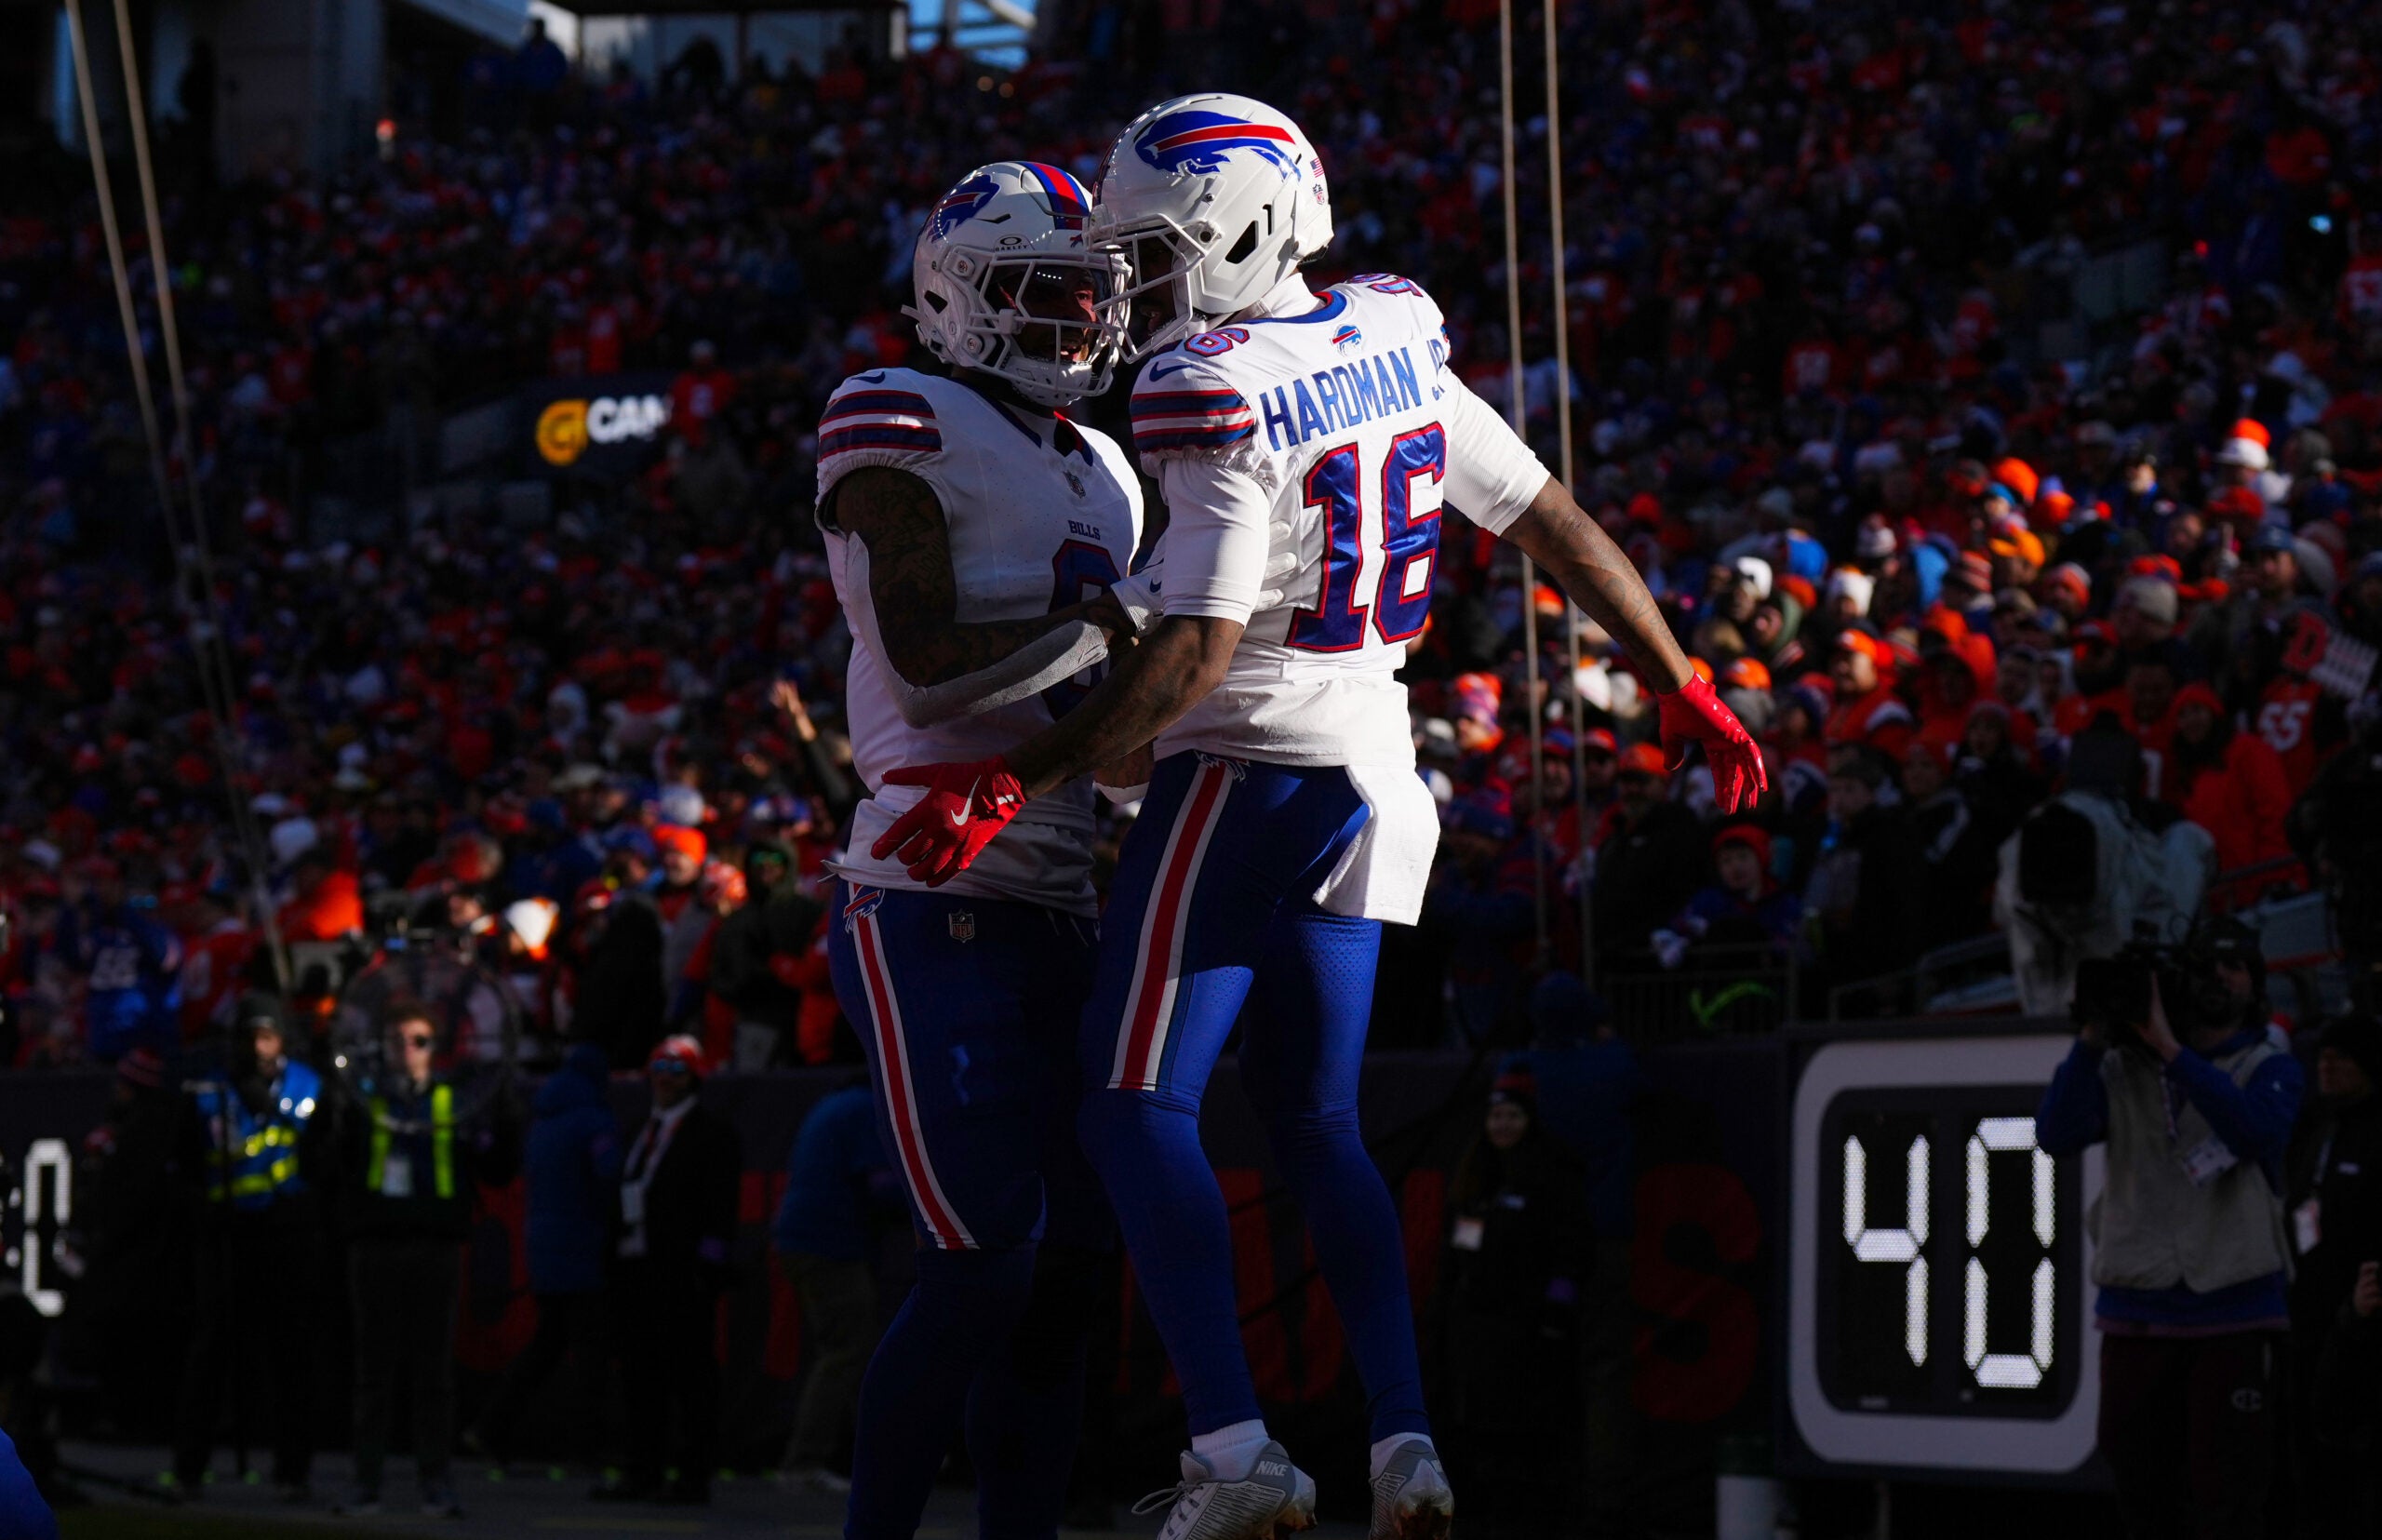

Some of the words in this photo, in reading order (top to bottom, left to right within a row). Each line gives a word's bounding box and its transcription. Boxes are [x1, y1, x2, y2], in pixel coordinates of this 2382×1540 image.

[995, 244, 1029, 252] OAKLEY
[1259, 346, 1423, 452] HARDMAN
[1067, 519, 1101, 541] BILLS
[1284, 421, 1447, 653] 16
[2256, 700, 2312, 753] 55
[1842, 1117, 2056, 1388] 40
[1255, 1460, 1289, 1477] NIKE
